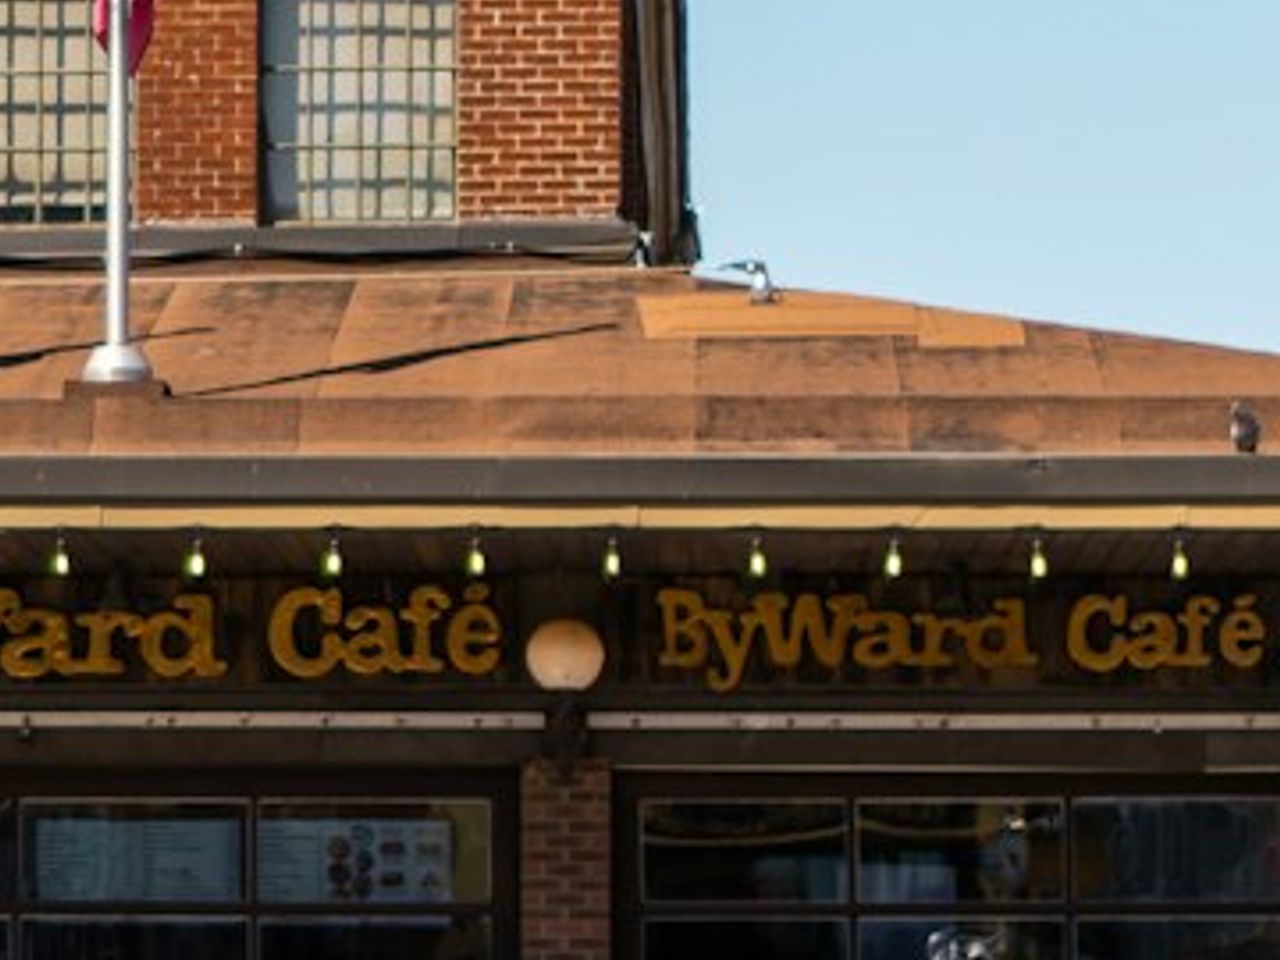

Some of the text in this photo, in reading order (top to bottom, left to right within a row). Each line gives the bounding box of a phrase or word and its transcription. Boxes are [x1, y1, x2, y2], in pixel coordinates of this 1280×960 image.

[266, 584, 503, 679] Café
[656, 588, 1267, 692] ByWard Café
